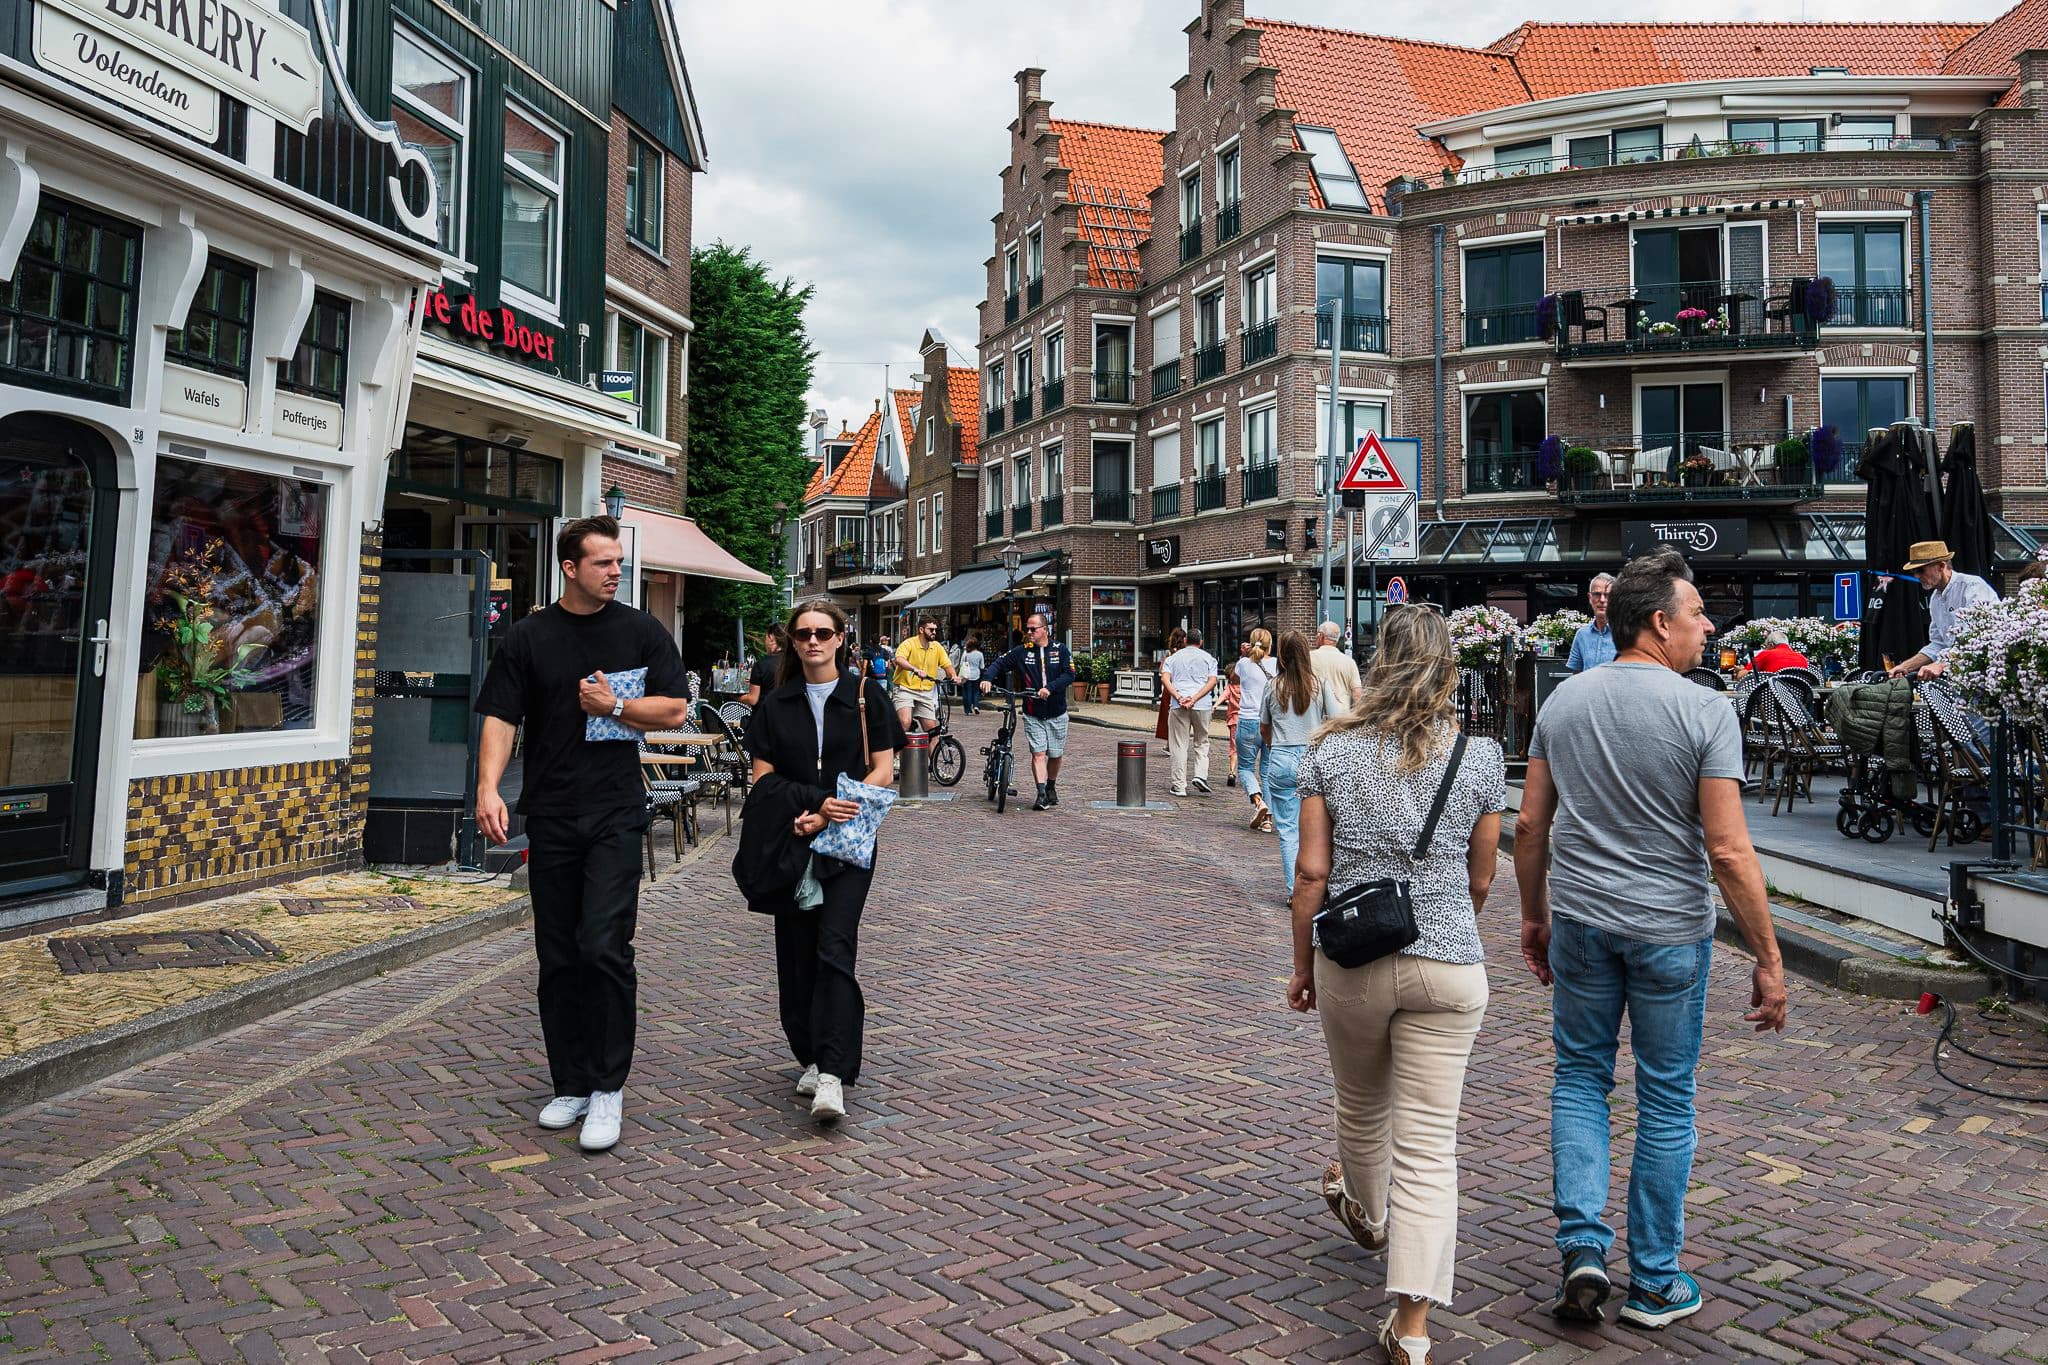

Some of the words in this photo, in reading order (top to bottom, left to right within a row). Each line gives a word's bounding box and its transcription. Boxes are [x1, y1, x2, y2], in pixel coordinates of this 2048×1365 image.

[73, 32, 190, 110] Volendam
[461, 294, 494, 340] de
[501, 307, 555, 362] Boer
[606, 374, 633, 384] KOOP
[184, 387, 220, 408] Wafels
[282, 409, 327, 430] Poffertjes
[134, 427, 144, 441] 58
[1378, 495, 1401, 503] ZONE
